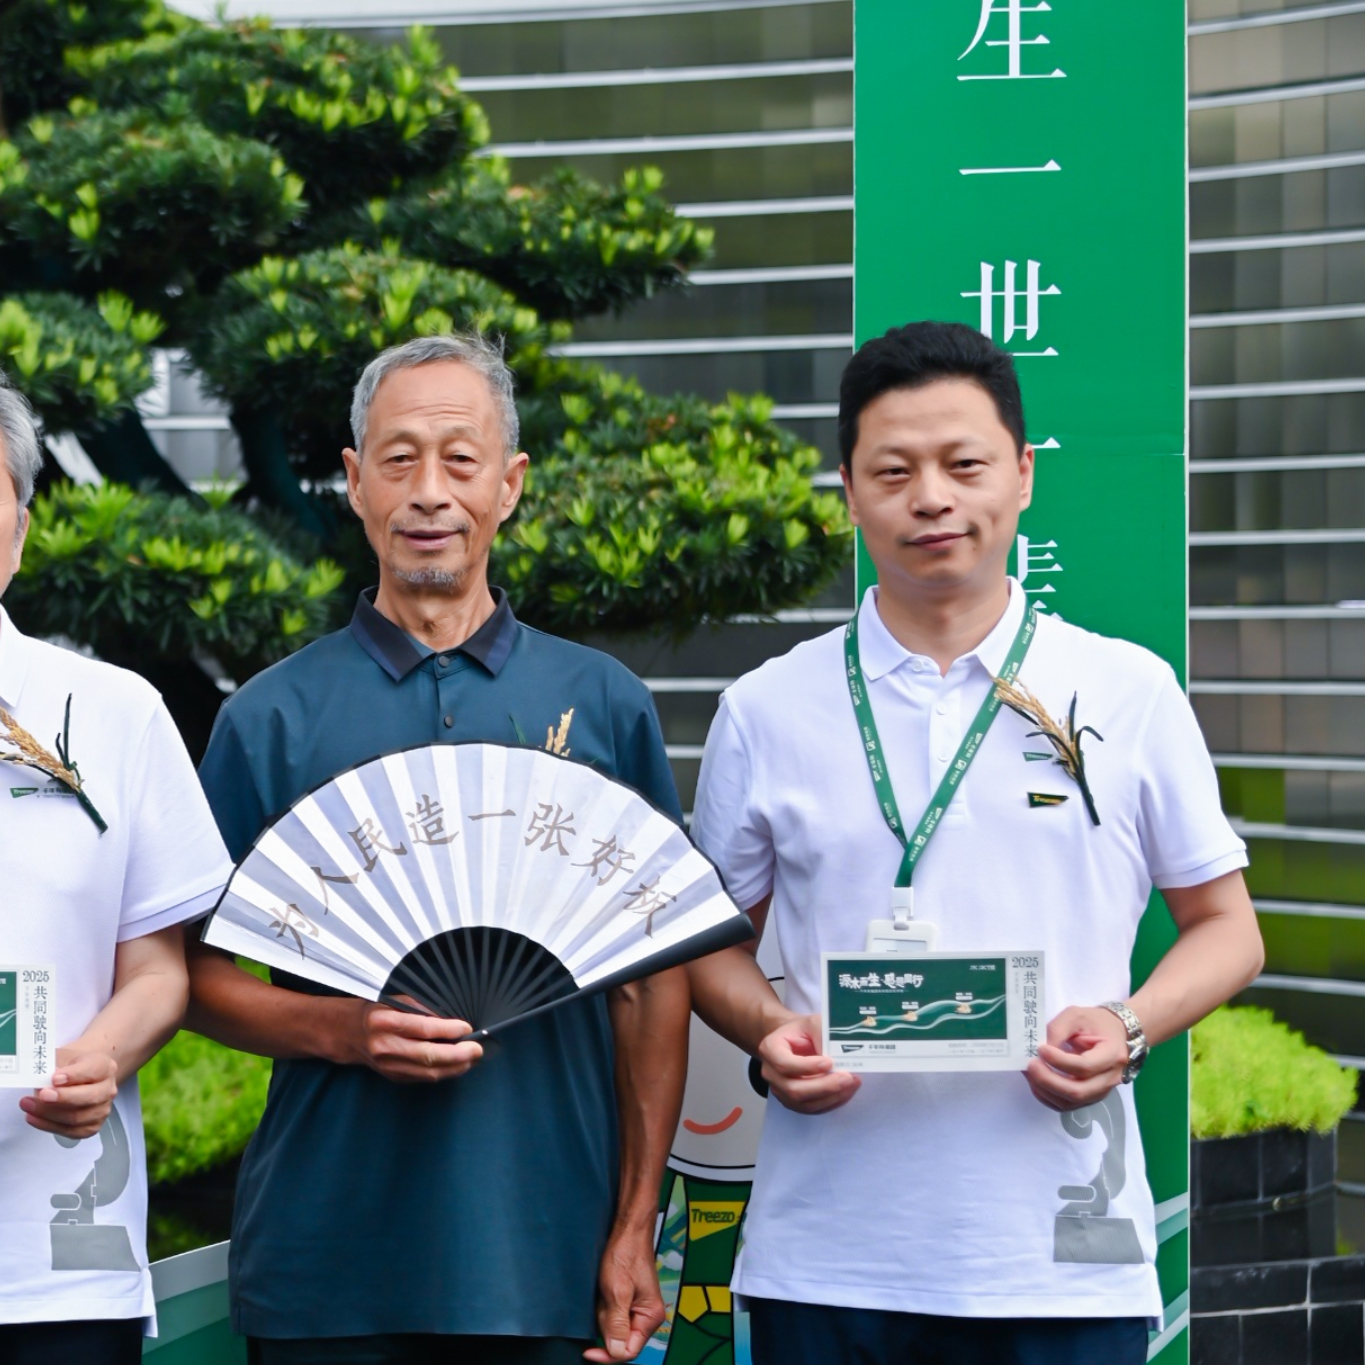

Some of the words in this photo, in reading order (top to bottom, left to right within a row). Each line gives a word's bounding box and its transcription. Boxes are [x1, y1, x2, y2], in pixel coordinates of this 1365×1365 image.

[268, 793, 678, 960] 为人民造一张好板
[1012, 957, 1039, 969] 2025
[23, 971, 50, 983] 2025
[692, 1209, 735, 1223] Treezo
